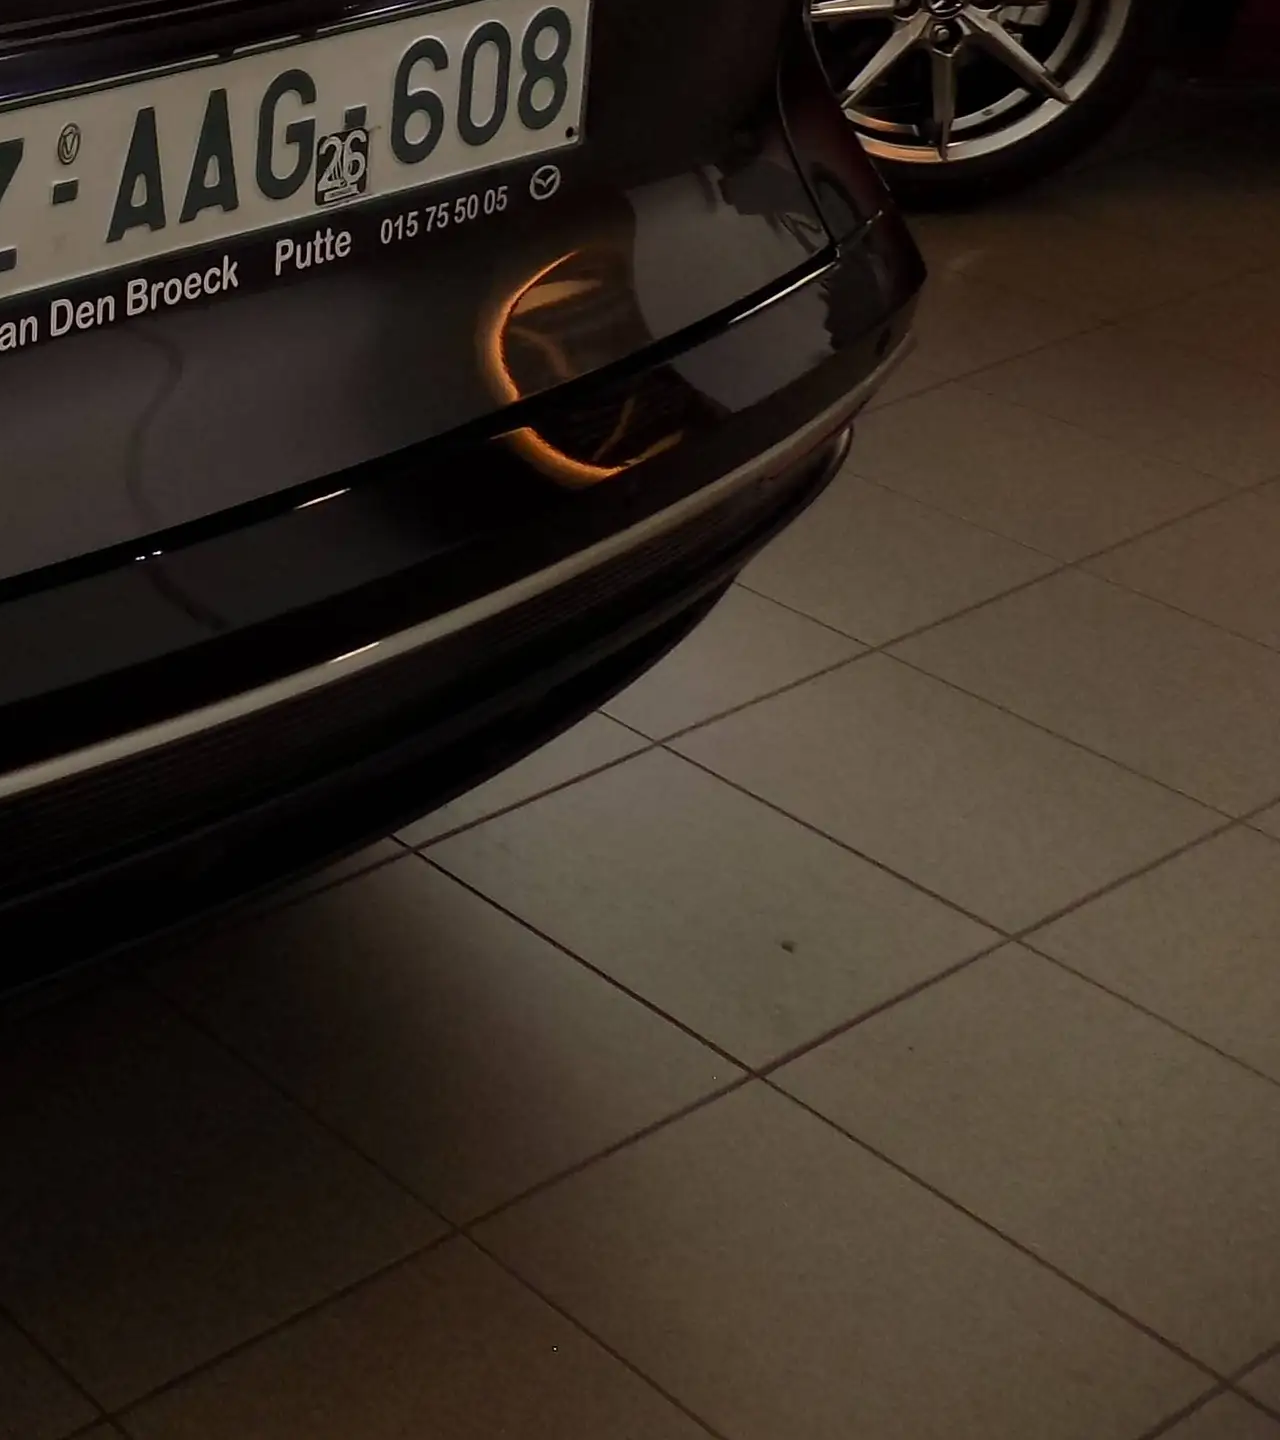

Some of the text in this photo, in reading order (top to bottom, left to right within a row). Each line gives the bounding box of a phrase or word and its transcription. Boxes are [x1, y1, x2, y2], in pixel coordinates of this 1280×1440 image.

[318, 130, 366, 192] 26
[50, 294, 115, 337] Den
[127, 255, 238, 317] Broeck
[275, 227, 351, 275] Putte
[381, 211, 418, 244] 015
[426, 200, 449, 231] 75
[454, 194, 479, 223] 50
[484, 186, 508, 215] 05
